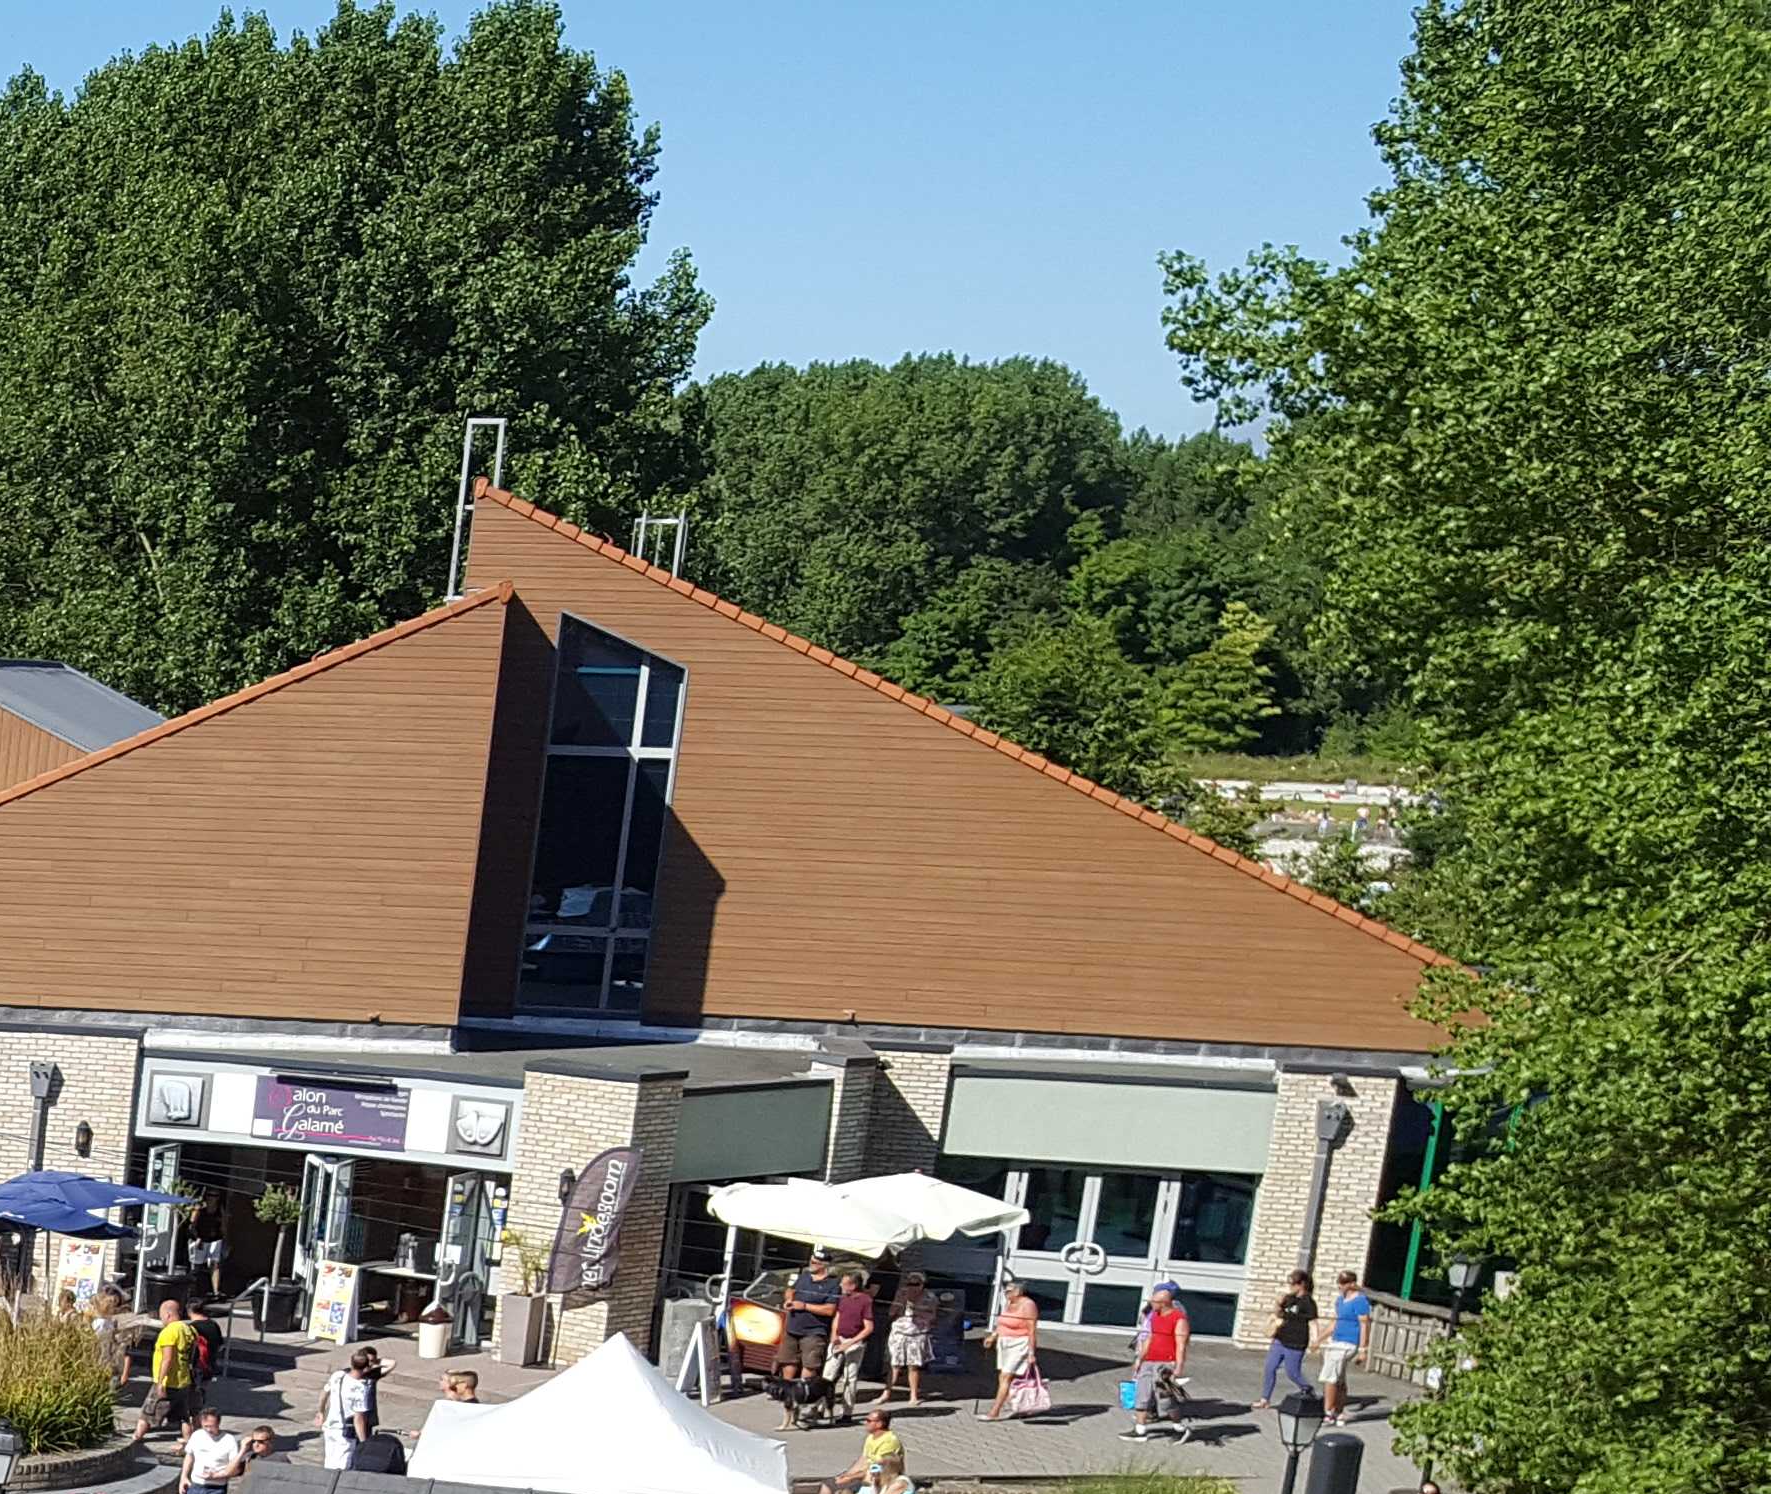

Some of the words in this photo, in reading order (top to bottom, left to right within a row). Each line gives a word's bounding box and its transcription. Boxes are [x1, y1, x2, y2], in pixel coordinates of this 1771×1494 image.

[278, 1103, 344, 1140] Galamé
[307, 1105, 320, 1115] du
[322, 1105, 344, 1117] Parc
